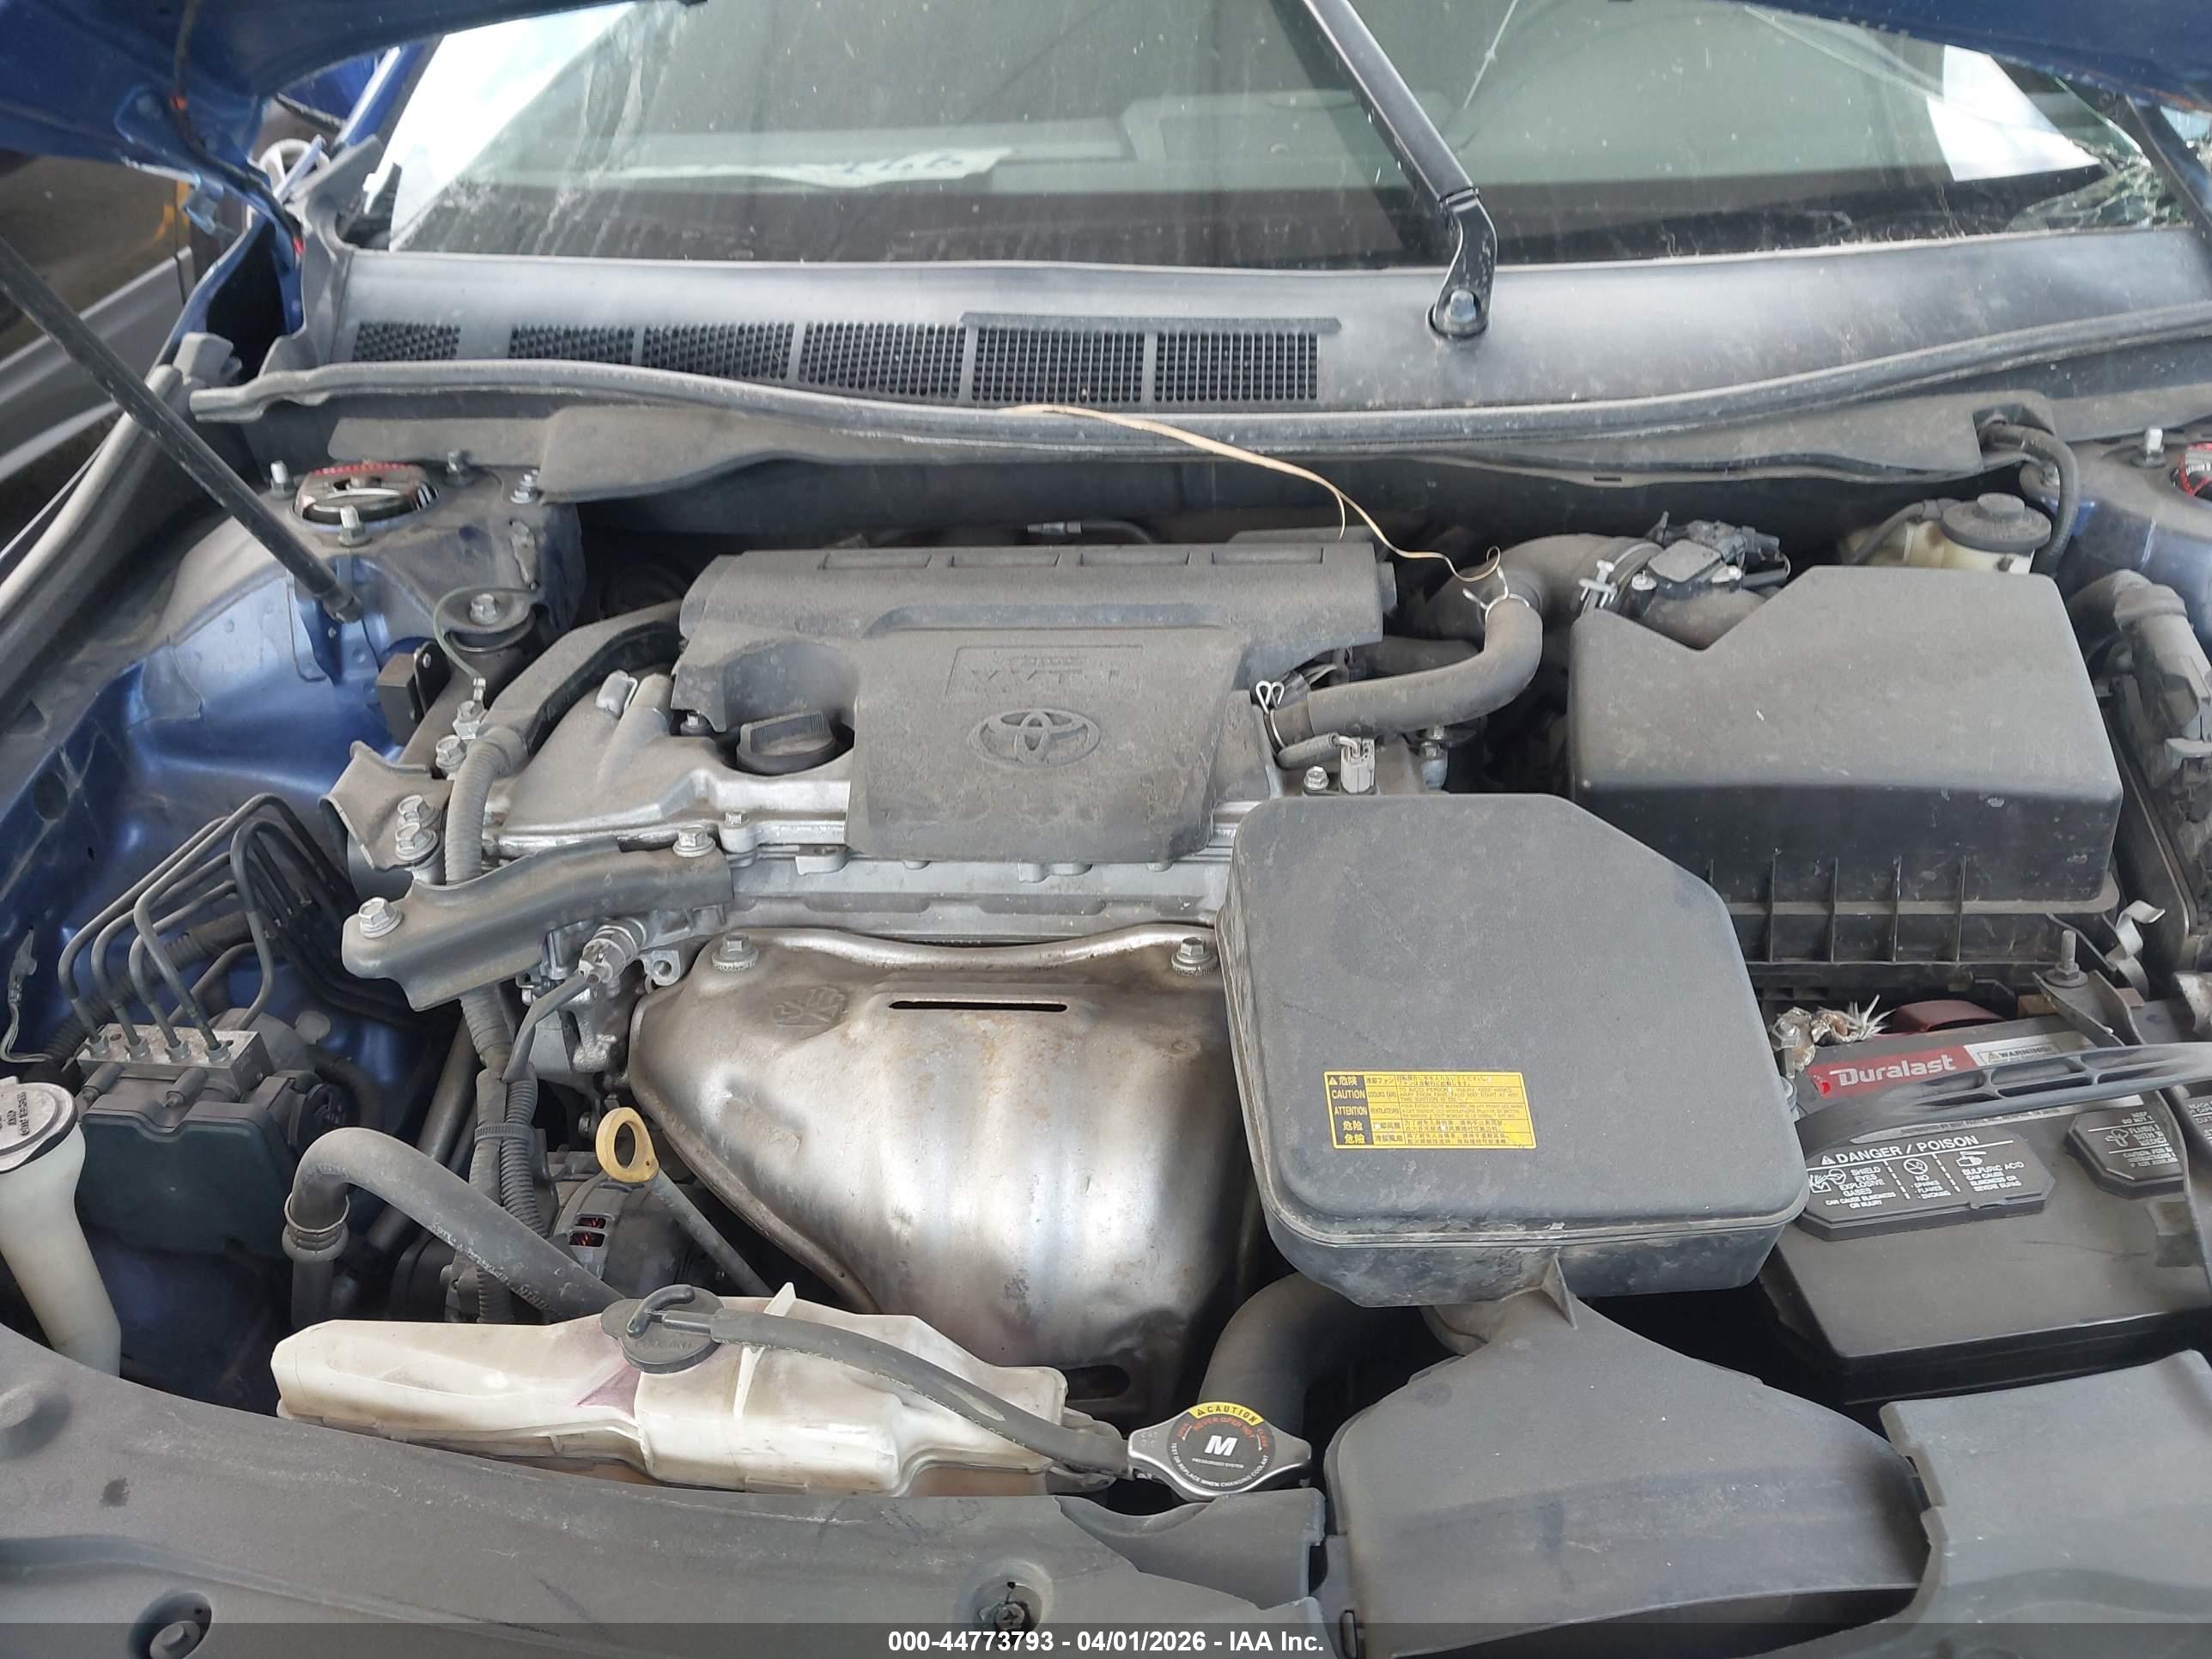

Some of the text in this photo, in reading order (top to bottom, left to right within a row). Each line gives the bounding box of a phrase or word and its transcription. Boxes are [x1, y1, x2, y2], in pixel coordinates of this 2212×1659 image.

[1829, 1054, 1956, 1087] Duralast
[1331, 1089, 1366, 1099] CAUTION
[1334, 1105, 1368, 1115] ATTENTION
[1835, 1135, 1979, 1164] DANGER / POISON
[1850, 1166, 1881, 1176] SHIELD
[1961, 1161, 2025, 1176] SULFURIC ACID
[1838, 1179, 1886, 1191] EXPLOSIVE
[1854, 1174, 1878, 1183] EYES
[1843, 1188, 1873, 1197] GASES
[1206, 1405, 1257, 1424] CAUTION
[1204, 1435, 1238, 1456] M
[1177, 1462, 1201, 1483] REPLACE
[1200, 1478, 1220, 1487] WHEN
[1220, 1475, 1253, 1487] CHANGING
[1251, 1455, 1270, 1477] COOLANT
